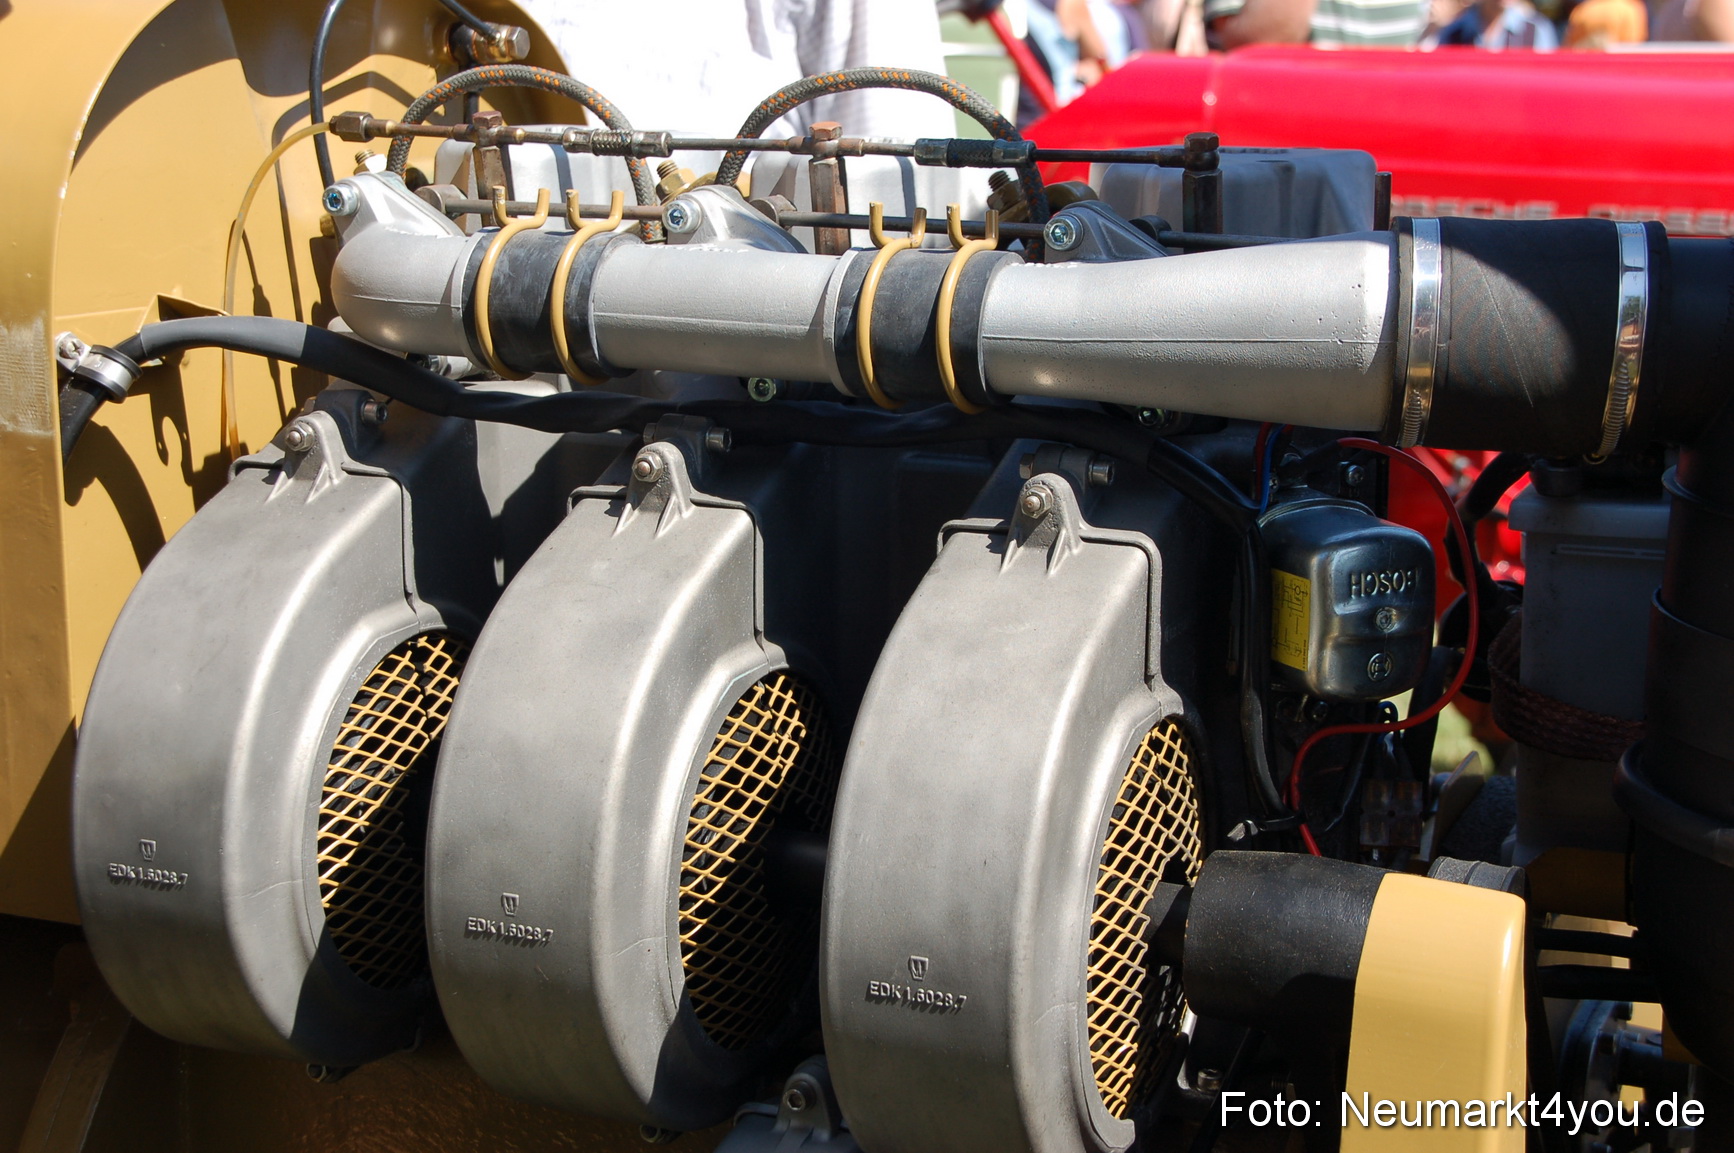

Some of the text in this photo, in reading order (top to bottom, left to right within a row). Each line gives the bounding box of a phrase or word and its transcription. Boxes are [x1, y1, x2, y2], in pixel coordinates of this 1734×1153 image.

[1351, 568, 1418, 599] BOSCH
[108, 862, 136, 879] EDK
[467, 916, 496, 934] EDK
[870, 980, 901, 999] EDK
